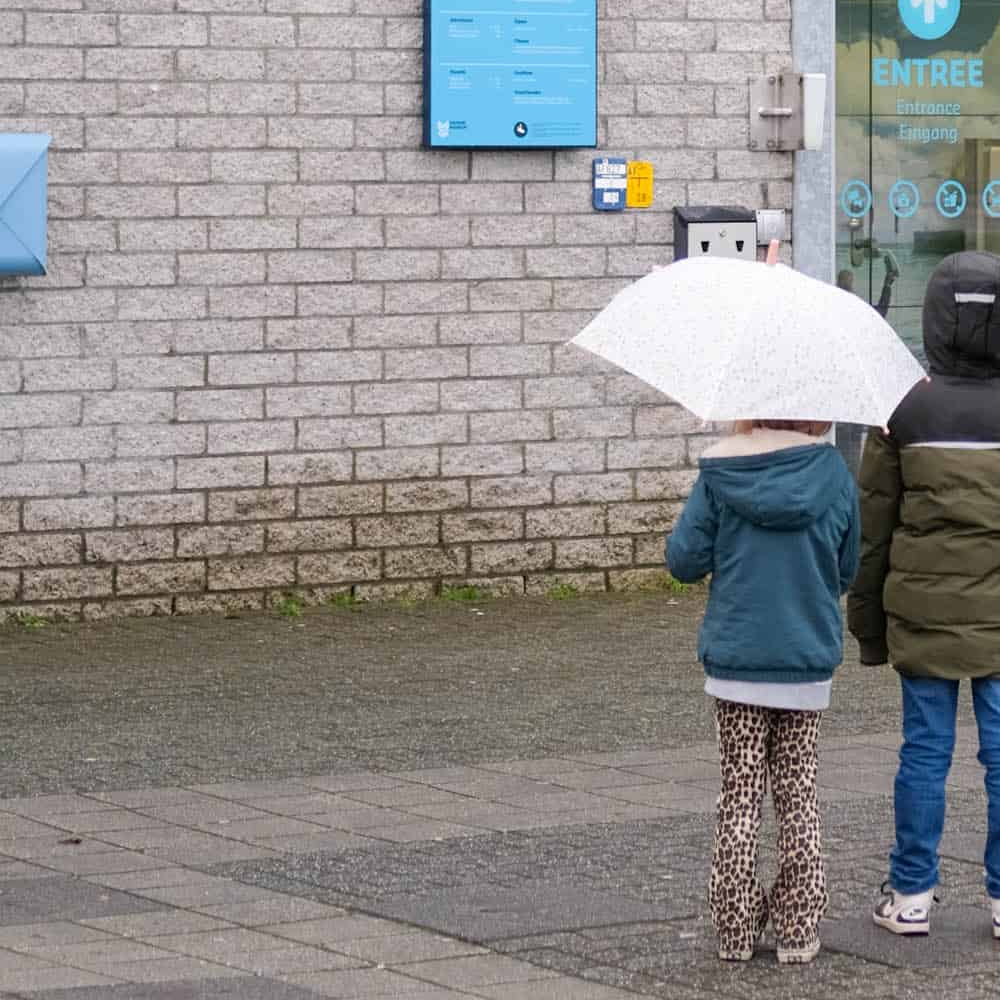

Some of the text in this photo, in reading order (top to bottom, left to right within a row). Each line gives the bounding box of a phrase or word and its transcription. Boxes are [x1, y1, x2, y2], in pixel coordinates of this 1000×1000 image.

[872, 56, 985, 89] ENTREE
[896, 98, 961, 115] Entrance
[899, 122, 959, 143] Eingang
